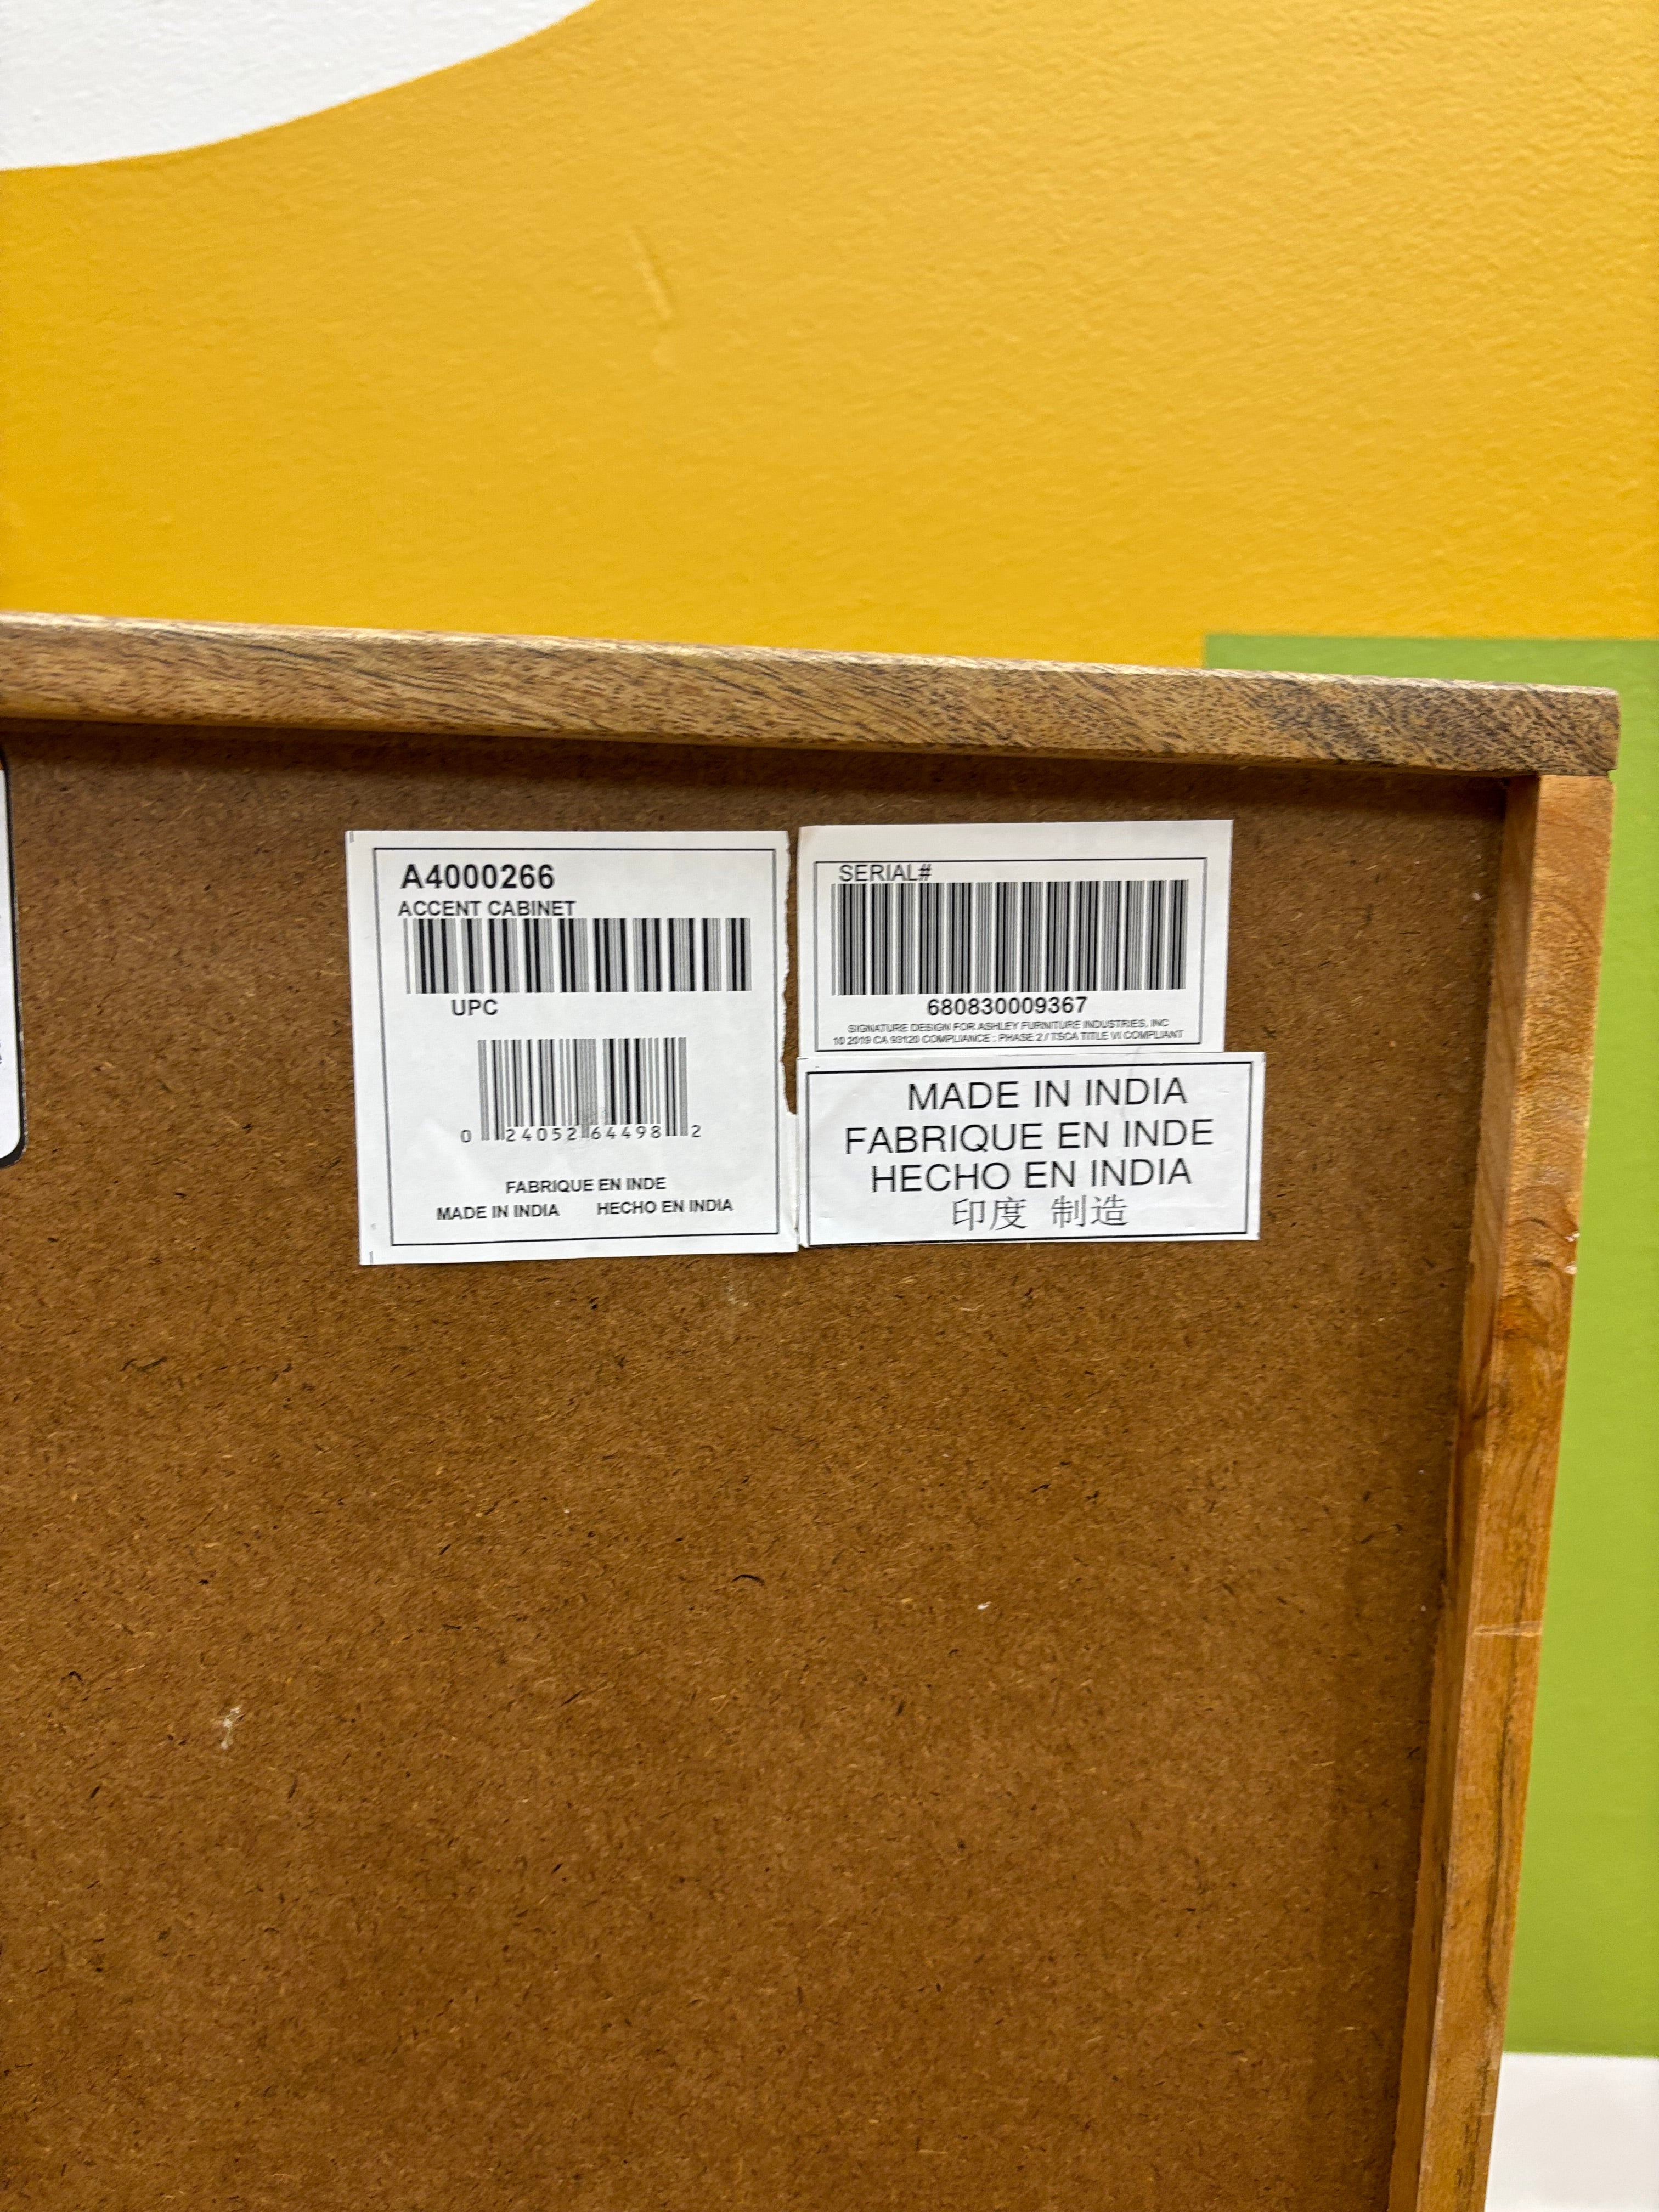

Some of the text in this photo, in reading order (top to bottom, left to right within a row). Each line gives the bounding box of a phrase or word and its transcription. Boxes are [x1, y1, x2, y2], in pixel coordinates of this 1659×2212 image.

[400, 864, 554, 889] A4000266
[839, 864, 932, 881] SERIAL#
[397, 900, 577, 916] ACCENT CABINET
[452, 999, 498, 1015] UPC
[927, 997, 1088, 1015] 680830009367
[847, 1024, 909, 1032] SIGNATURE
[910, 1023, 951, 1031] DESIGN
[977, 1021, 1019, 1030] ASHLEY
[1021, 1020, 1081, 1029] FURNITURE
[1150, 1018, 1170, 1027] INC
[873, 1036, 889, 1044] CA
[922, 1034, 991, 1043] COMPLIANCE
[998, 1033, 1035, 1042] PHASE
[1036, 1033, 1043, 1041] 2
[1043, 1032, 1049, 1041] /
[1050, 1032, 1079, 1041] TSCA
[1080, 1031, 1109, 1040] TITLE
[1124, 1030, 1184, 1039] COMPLIANT
[908, 1077, 1188, 1110] MADE IN INDIA
[460, 1124, 702, 1143] 0 24052 64498 2
[844, 1119, 1214, 1154] FABRIQUE EN INDE
[871, 1158, 1193, 1192] HECHO EN INDIA
[505, 1177, 667, 1194] FABRIQUE EN INDE
[436, 1204, 560, 1220] MADE IN INDIA
[596, 1198, 735, 1215] HECHO EN INDIA
[951, 1194, 1128, 1231] 印度 制造
